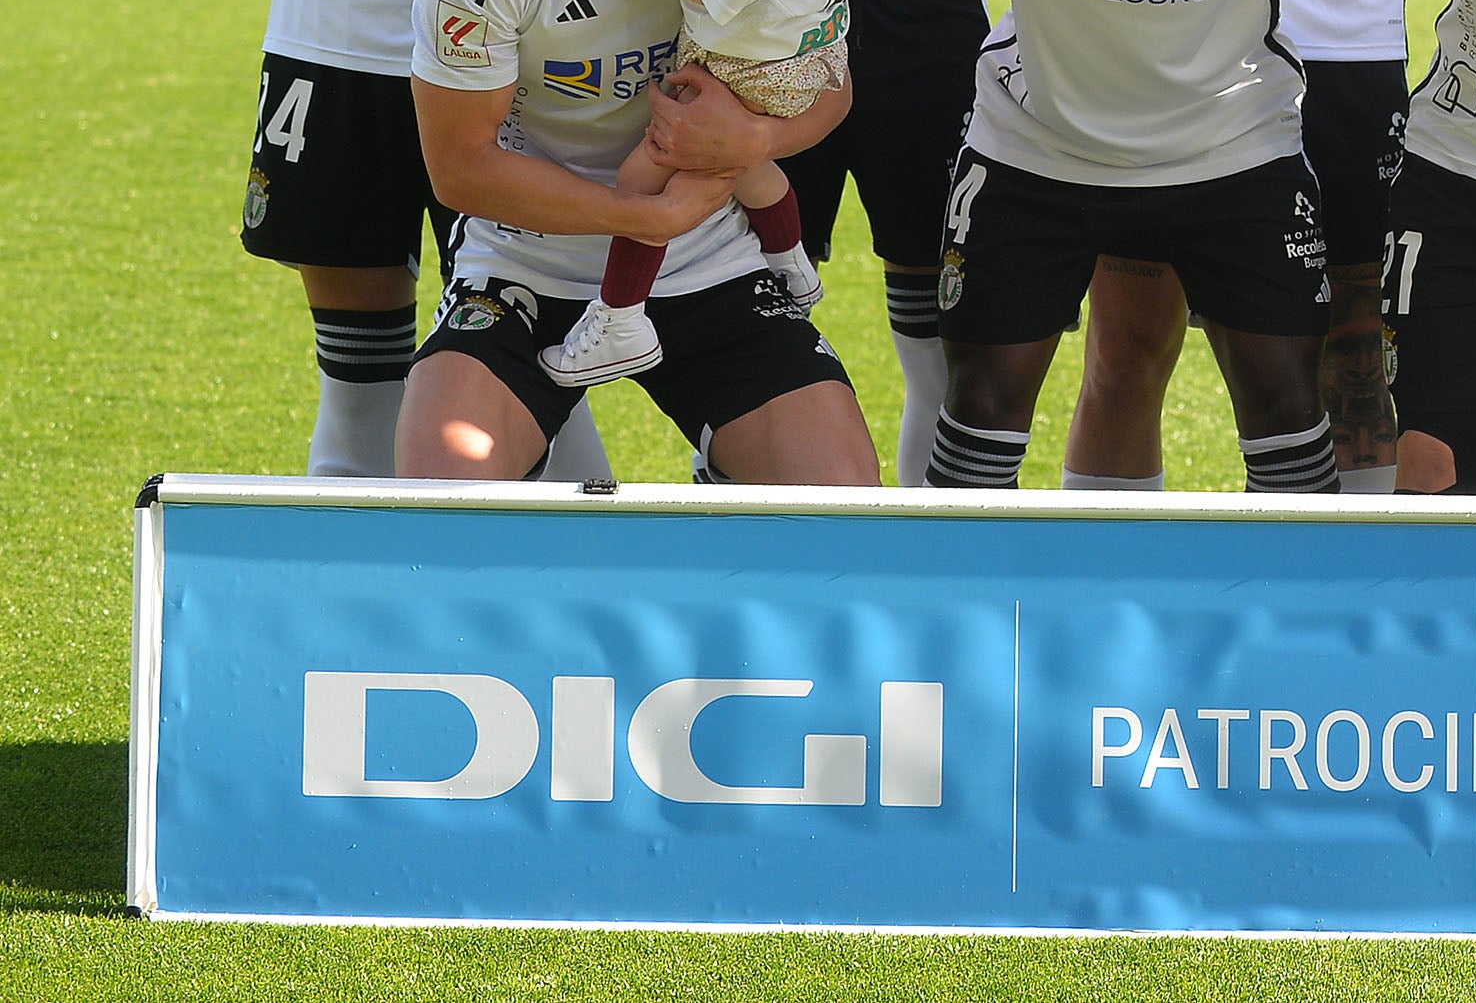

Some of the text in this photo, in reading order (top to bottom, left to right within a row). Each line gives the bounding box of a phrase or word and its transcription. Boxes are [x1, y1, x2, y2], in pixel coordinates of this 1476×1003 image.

[443, 47, 482, 59] LALIGA
[947, 164, 988, 245] 4
[303, 670, 943, 808] DIGI
